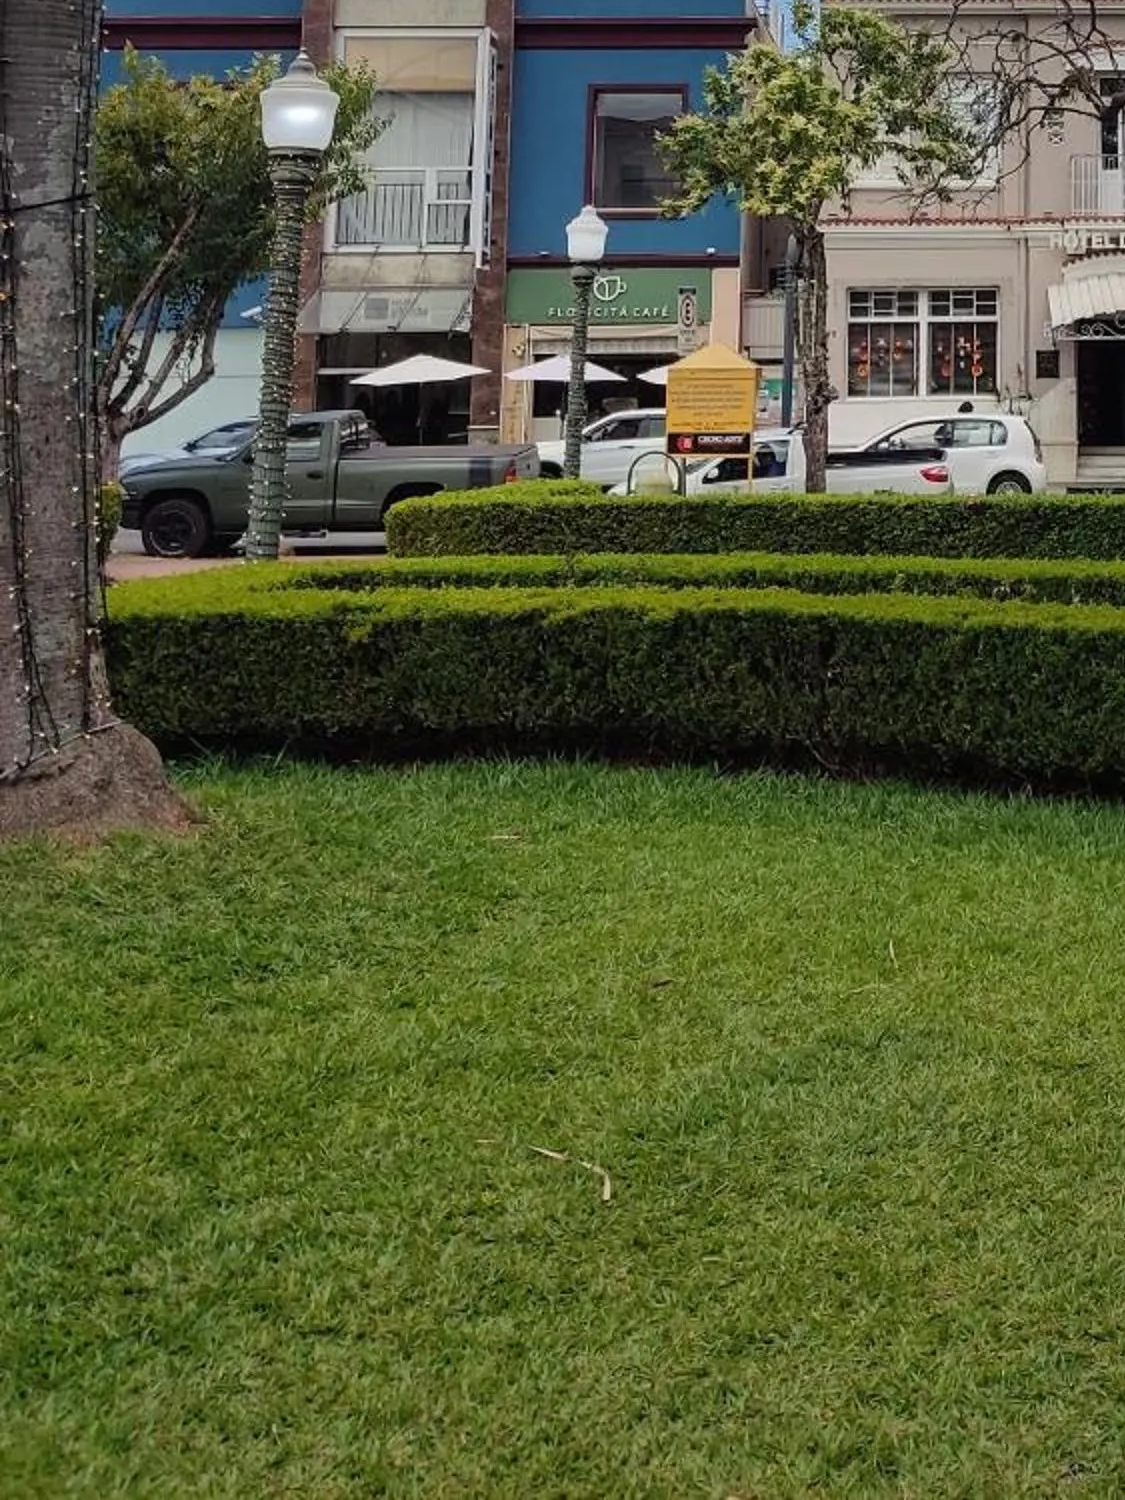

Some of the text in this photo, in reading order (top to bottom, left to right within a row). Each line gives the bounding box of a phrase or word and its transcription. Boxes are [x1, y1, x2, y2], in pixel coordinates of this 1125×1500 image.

[1050, 231, 1115, 249] HOTEL
[548, 305, 671, 318] FLOCITÁ CAFÉ
